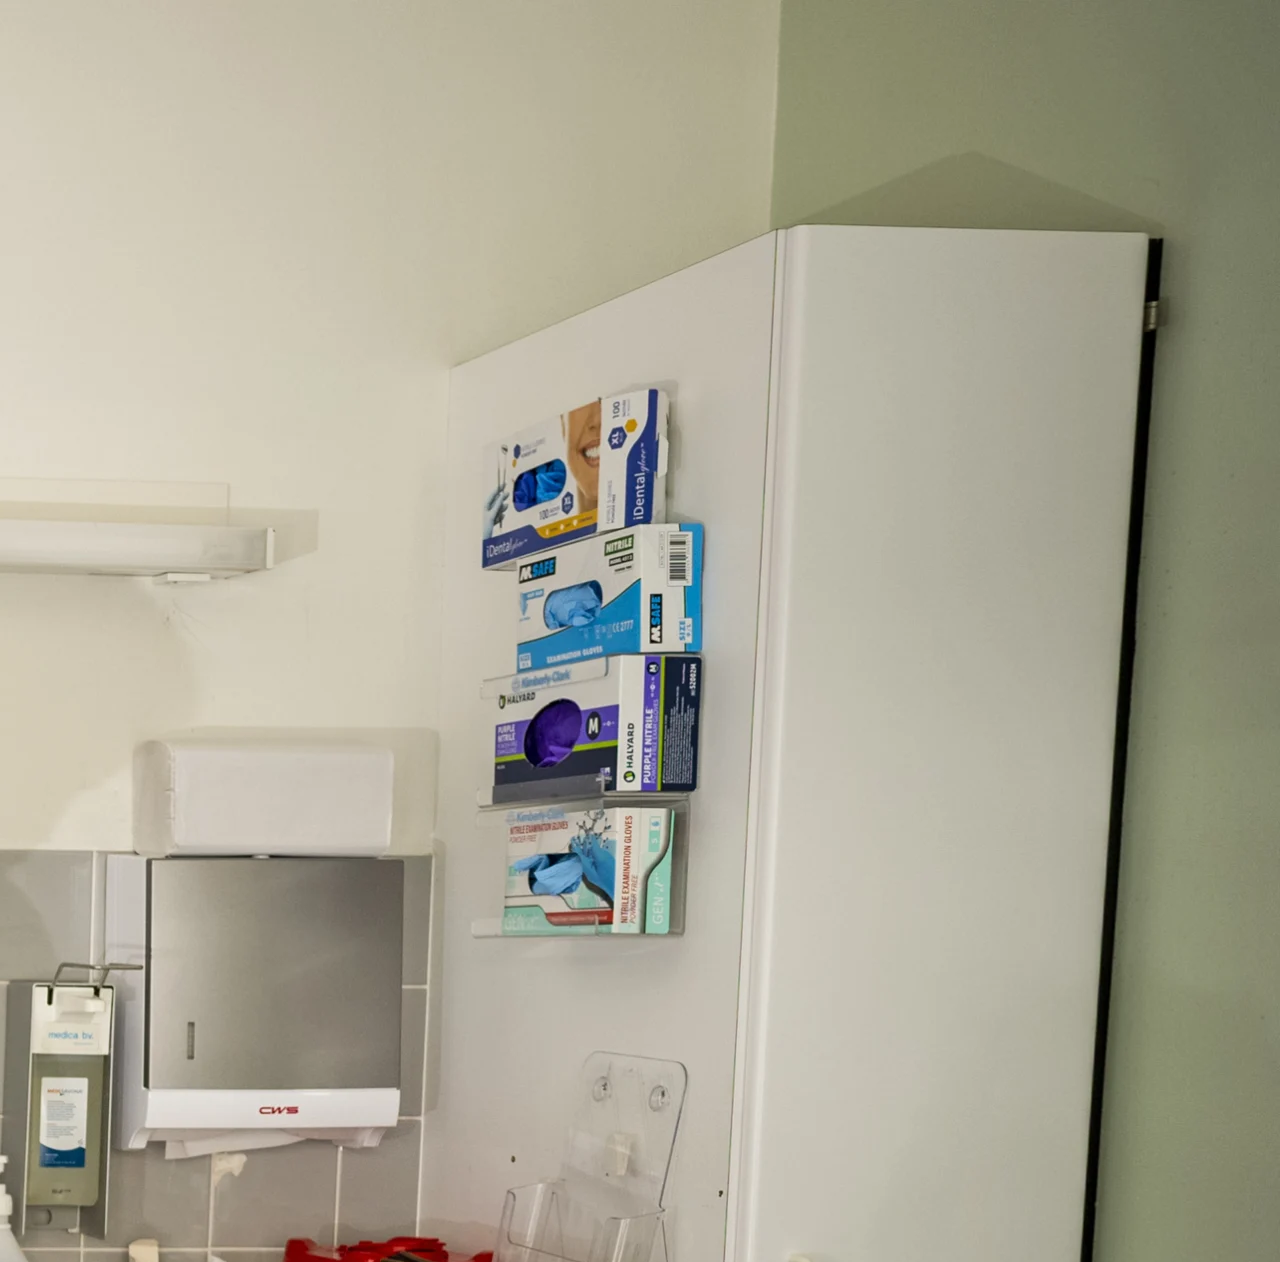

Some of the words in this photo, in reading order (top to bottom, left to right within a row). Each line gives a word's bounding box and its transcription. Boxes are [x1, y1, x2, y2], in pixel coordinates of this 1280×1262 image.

[612, 401, 621, 419] 100
[611, 431, 620, 445] XL
[605, 537, 634, 553] NITRILE
[547, 649, 582, 663] EXAMINATION
[582, 646, 603, 656] GLOVES
[506, 692, 536, 705] HALYARD
[498, 724, 515, 734] PURPLE
[589, 718, 599, 734] M
[497, 733, 515, 743] NITRILE
[626, 723, 635, 768] HALYARD
[643, 746, 652, 784] PURPLE
[551, 820, 568, 831] GLOVES
[623, 815, 633, 843] GLOVES
[621, 846, 631, 894] EXAMINATION
[620, 896, 629, 924] NITRILE
[48, 1031, 79, 1040] medica
[259, 1106, 299, 1114] CWS
